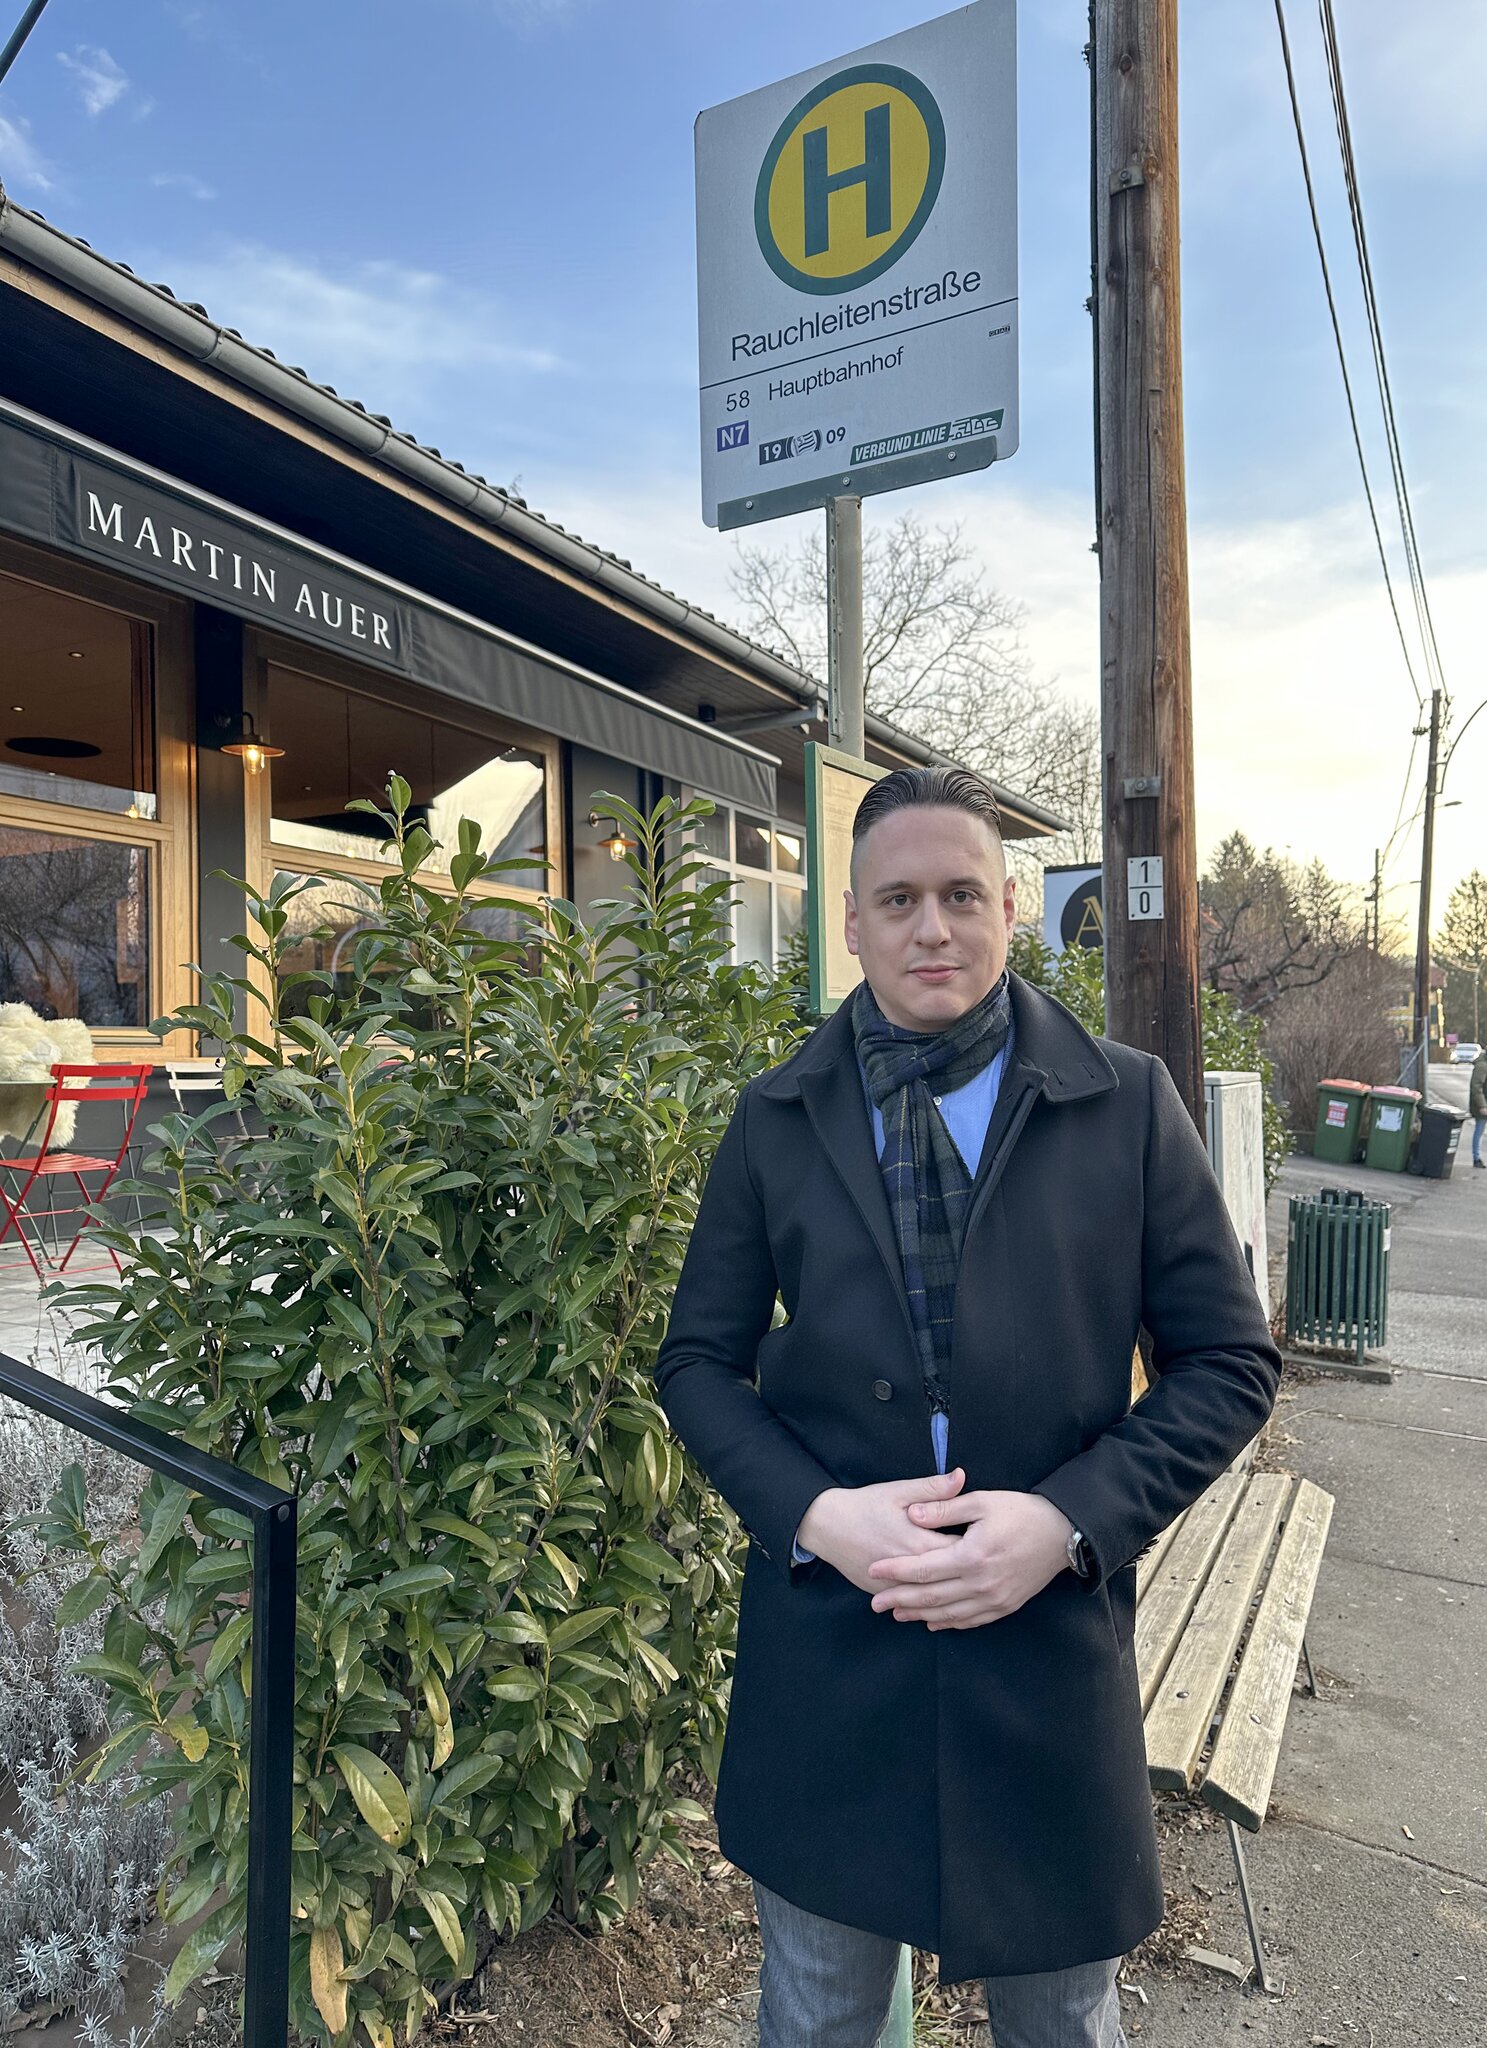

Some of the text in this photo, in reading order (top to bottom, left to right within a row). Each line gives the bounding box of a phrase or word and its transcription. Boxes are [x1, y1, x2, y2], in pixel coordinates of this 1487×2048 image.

[803, 102, 892, 259] H
[731, 270, 982, 361] Rauchleitenstraße
[726, 346, 904, 412] 58 Hauptbahnhof
[721, 424, 746, 448] N7
[763, 426, 846, 461] 19 09
[855, 425, 947, 462] VERBUND LINIE
[87, 491, 392, 650] MARTIN AUER
[1140, 860, 1148, 883] 1
